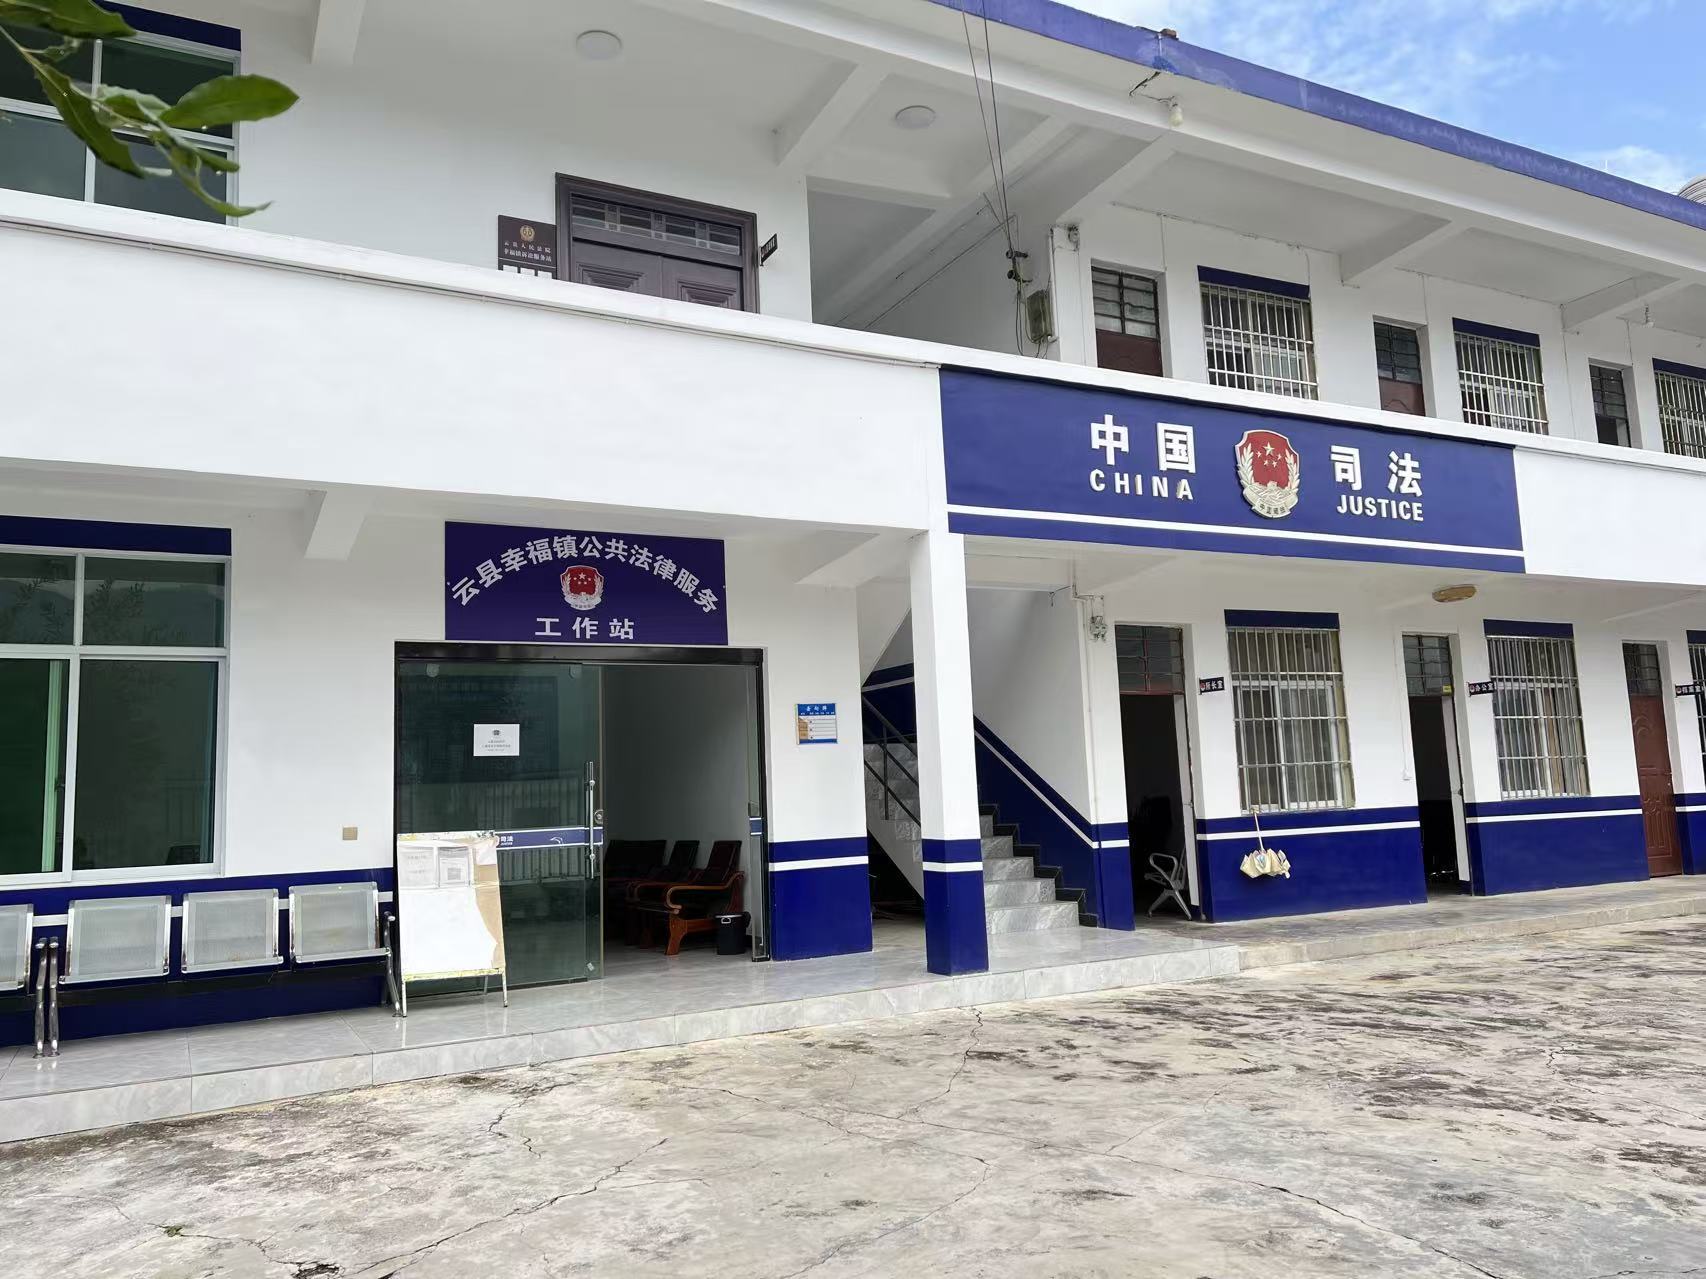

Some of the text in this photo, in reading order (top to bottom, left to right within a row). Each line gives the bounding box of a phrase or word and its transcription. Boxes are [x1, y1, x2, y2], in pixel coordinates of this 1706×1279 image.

[1090, 414, 1423, 497] 中国 司法
[1090, 469, 1424, 521] CHINA JUSTICE
[452, 535, 719, 613] 云县幸福镇公共法律服务
[535, 617, 634, 640] 工作站
[1475, 682, 1493, 692] 办公室
